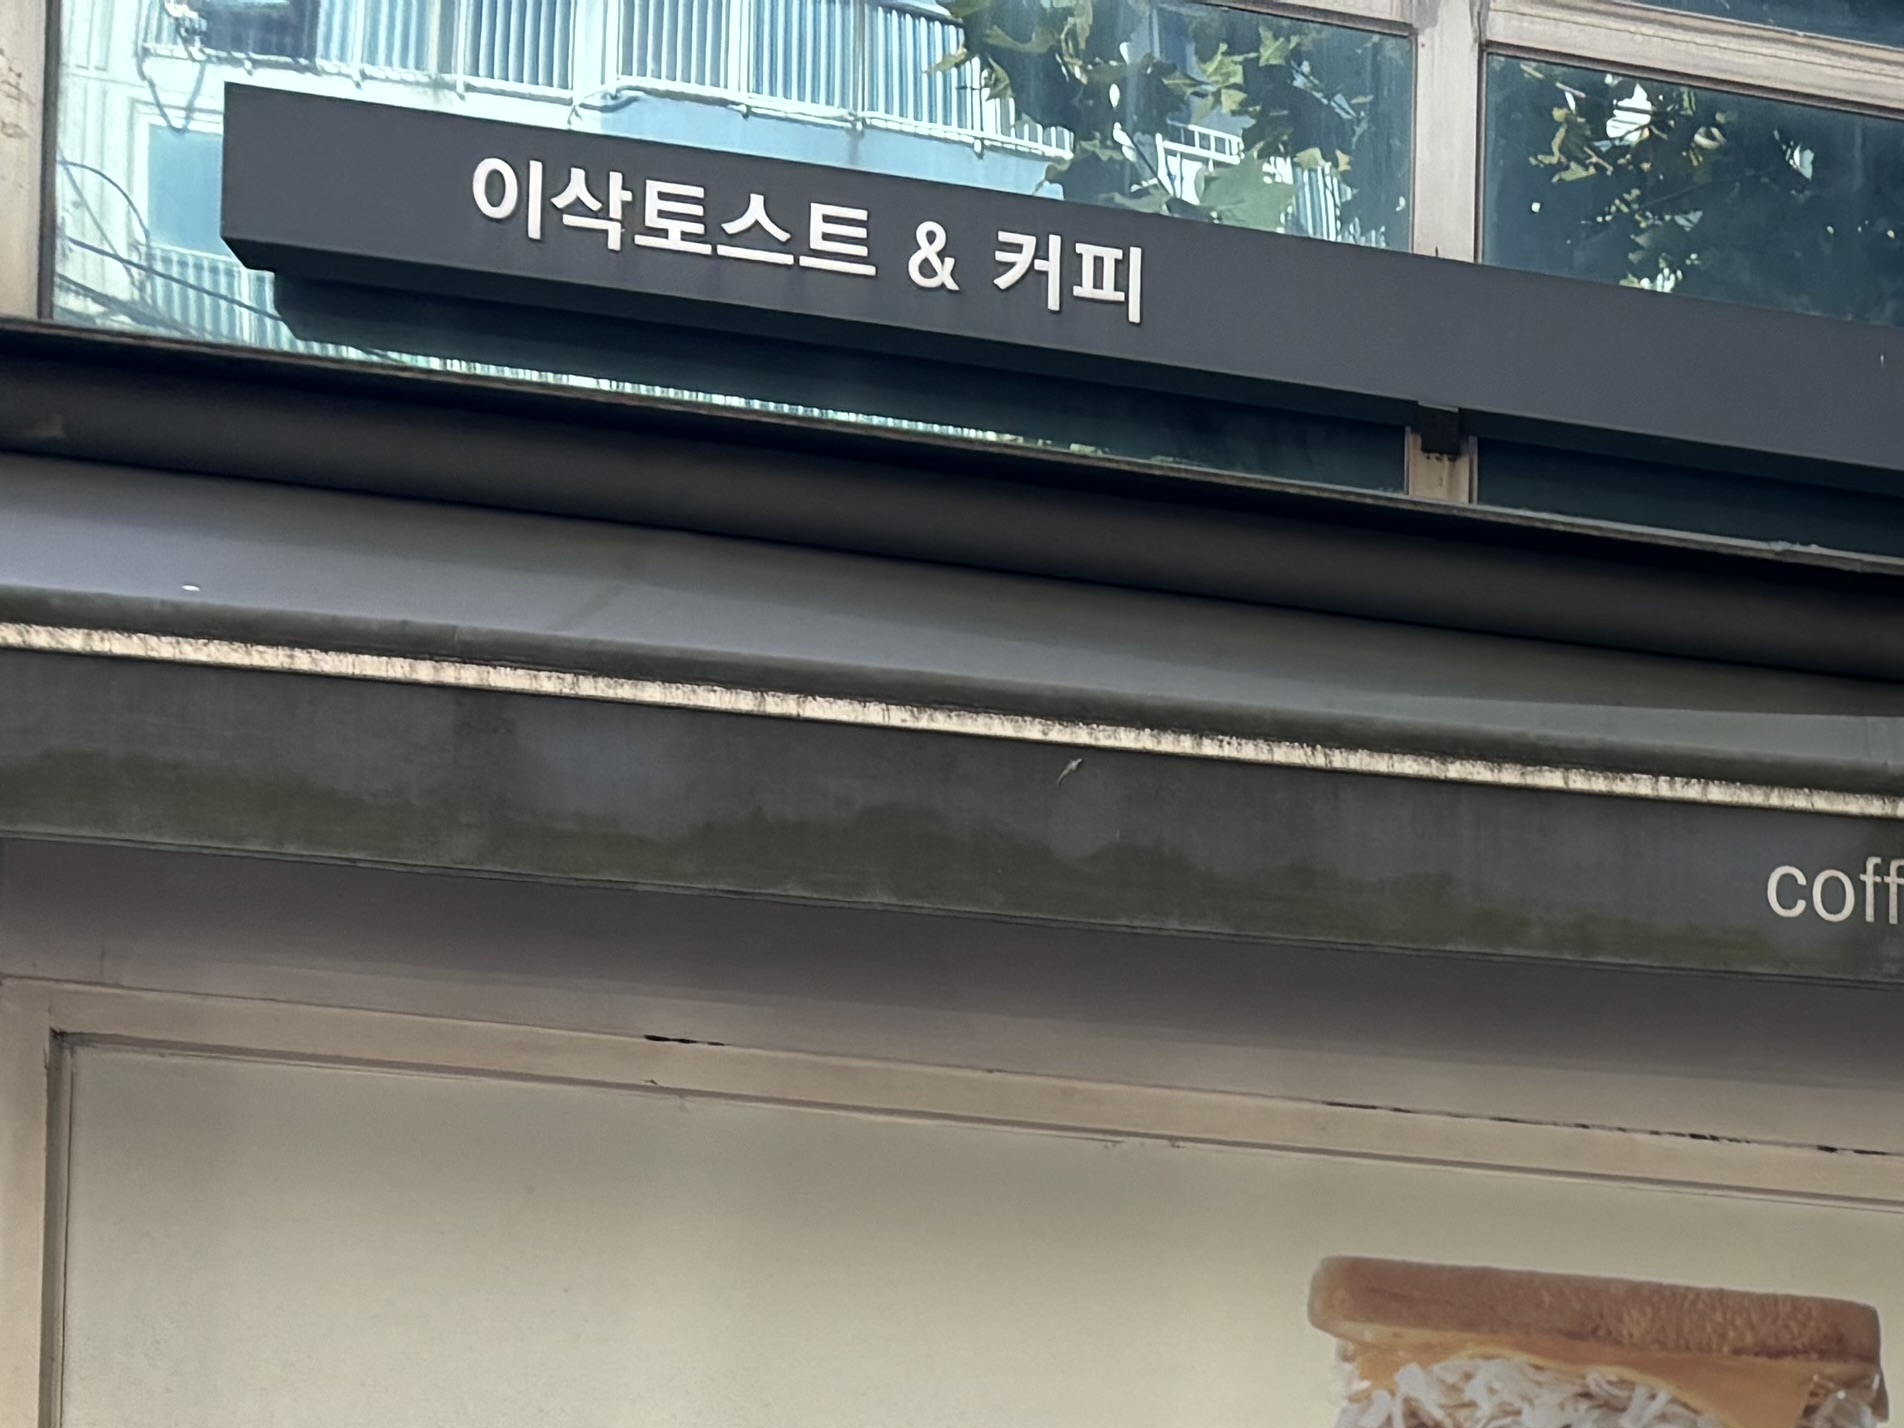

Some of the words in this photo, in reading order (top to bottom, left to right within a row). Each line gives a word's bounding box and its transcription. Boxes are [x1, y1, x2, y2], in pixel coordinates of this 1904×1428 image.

[472, 158, 876, 277] 이삭토스트
[908, 221, 958, 291] &
[993, 230, 1142, 323] 커피
